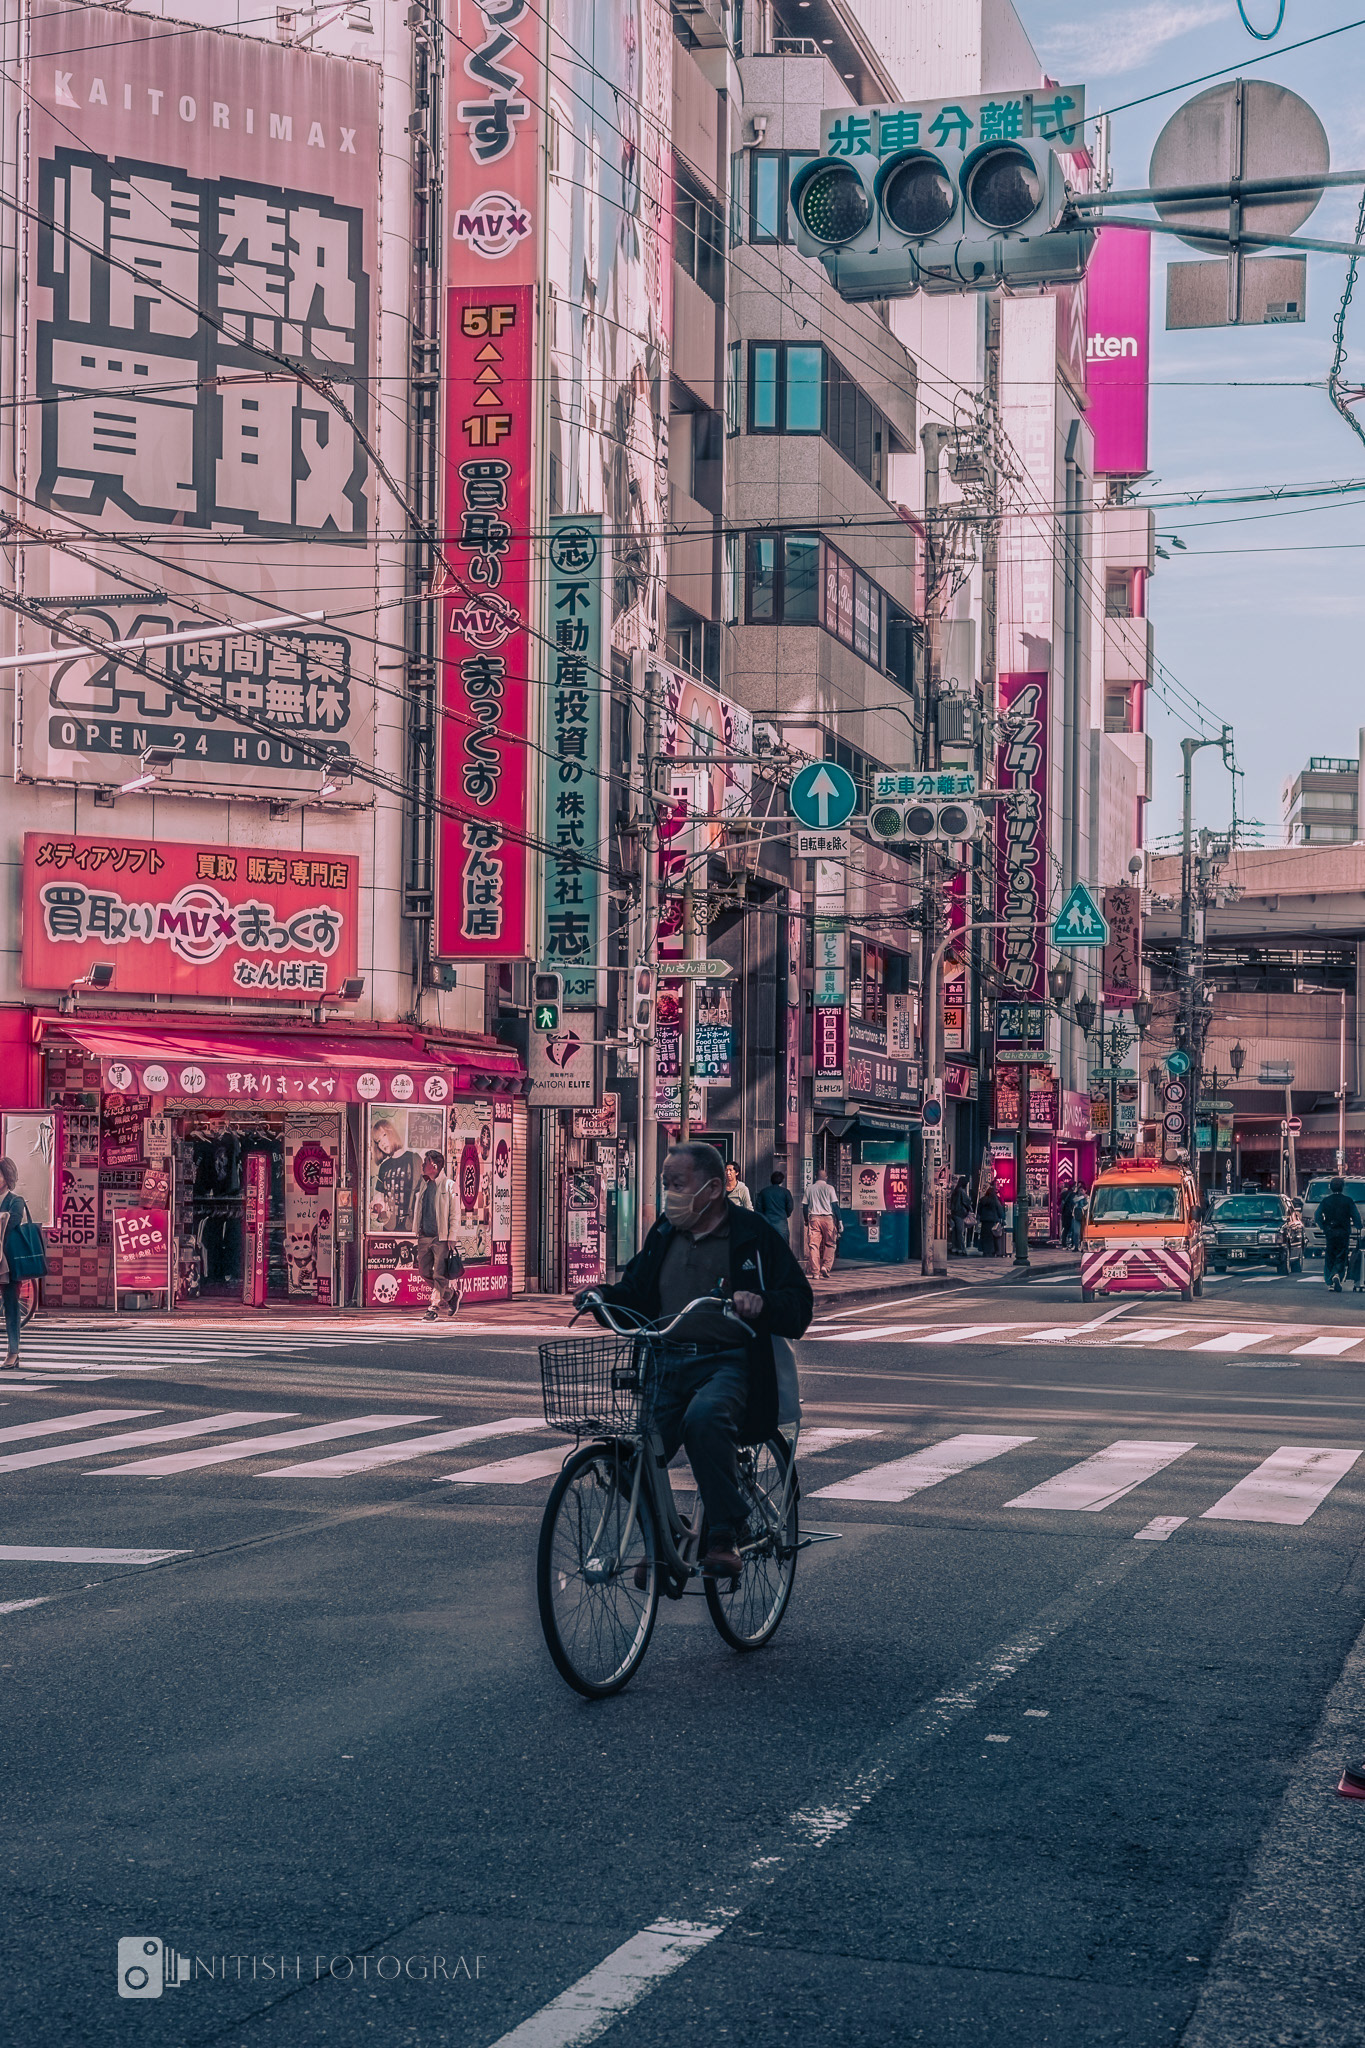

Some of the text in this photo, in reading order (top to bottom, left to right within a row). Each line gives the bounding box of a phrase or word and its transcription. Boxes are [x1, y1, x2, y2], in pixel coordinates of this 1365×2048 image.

[54, 69, 358, 155] KAITORIMAX
[828, 95, 1076, 155] 歩車分離式
[45, 155, 362, 366] 情熱
[461, 304, 517, 338] 5F
[45, 338, 362, 538] 買取
[462, 414, 513, 447] 1F
[50, 606, 173, 718] 24
[182, 634, 346, 685] 時間営業
[184, 671, 346, 727] 年中無休
[60, 722, 148, 750] OPEN
[173, 732, 209, 756] 24
[546, 581, 591, 956] 不動産投資の 株式会社 志
[877, 774, 976, 797] 歩車分離式
[800, 836, 848, 852] 自転車を除く
[36, 843, 349, 889] メディアソフト 買取 販売 専門店
[823, 932, 838, 968] はしもと
[235, 960, 327, 989] なんば店
[823, 968, 837, 993] 歯科
[820, 994, 840, 1004] 7F
[818, 1007, 842, 1016] スマホ!
[696, 1031, 730, 1039] フードホール
[696, 1036, 731, 1046] Food Court
[824, 1015, 837, 1068] 高価買取
[1004, 1051, 1045, 1060] なんさん通り
[226, 1072, 337, 1095] 買取りまっくす
[428, 1081, 444, 1098] 売
[533, 1080, 591, 1089] KAITORI ELITE
[664, 1087, 679, 1097] 3F
[816, 1084, 842, 1093] 辻村ビル
[582, 1119, 608, 1128] HOLIC
[1168, 1117, 1181, 1128] 40
[62, 1196, 95, 1213] AX
[61, 1213, 95, 1228] REE
[115, 1215, 153, 1235] Tax
[49, 1229, 95, 1244] SHOP
[118, 1230, 163, 1252] Free
[495, 1242, 508, 1252] TAX
[494, 1254, 508, 1265] FREE
[459, 1275, 508, 1293] TAX FREE SHOP
